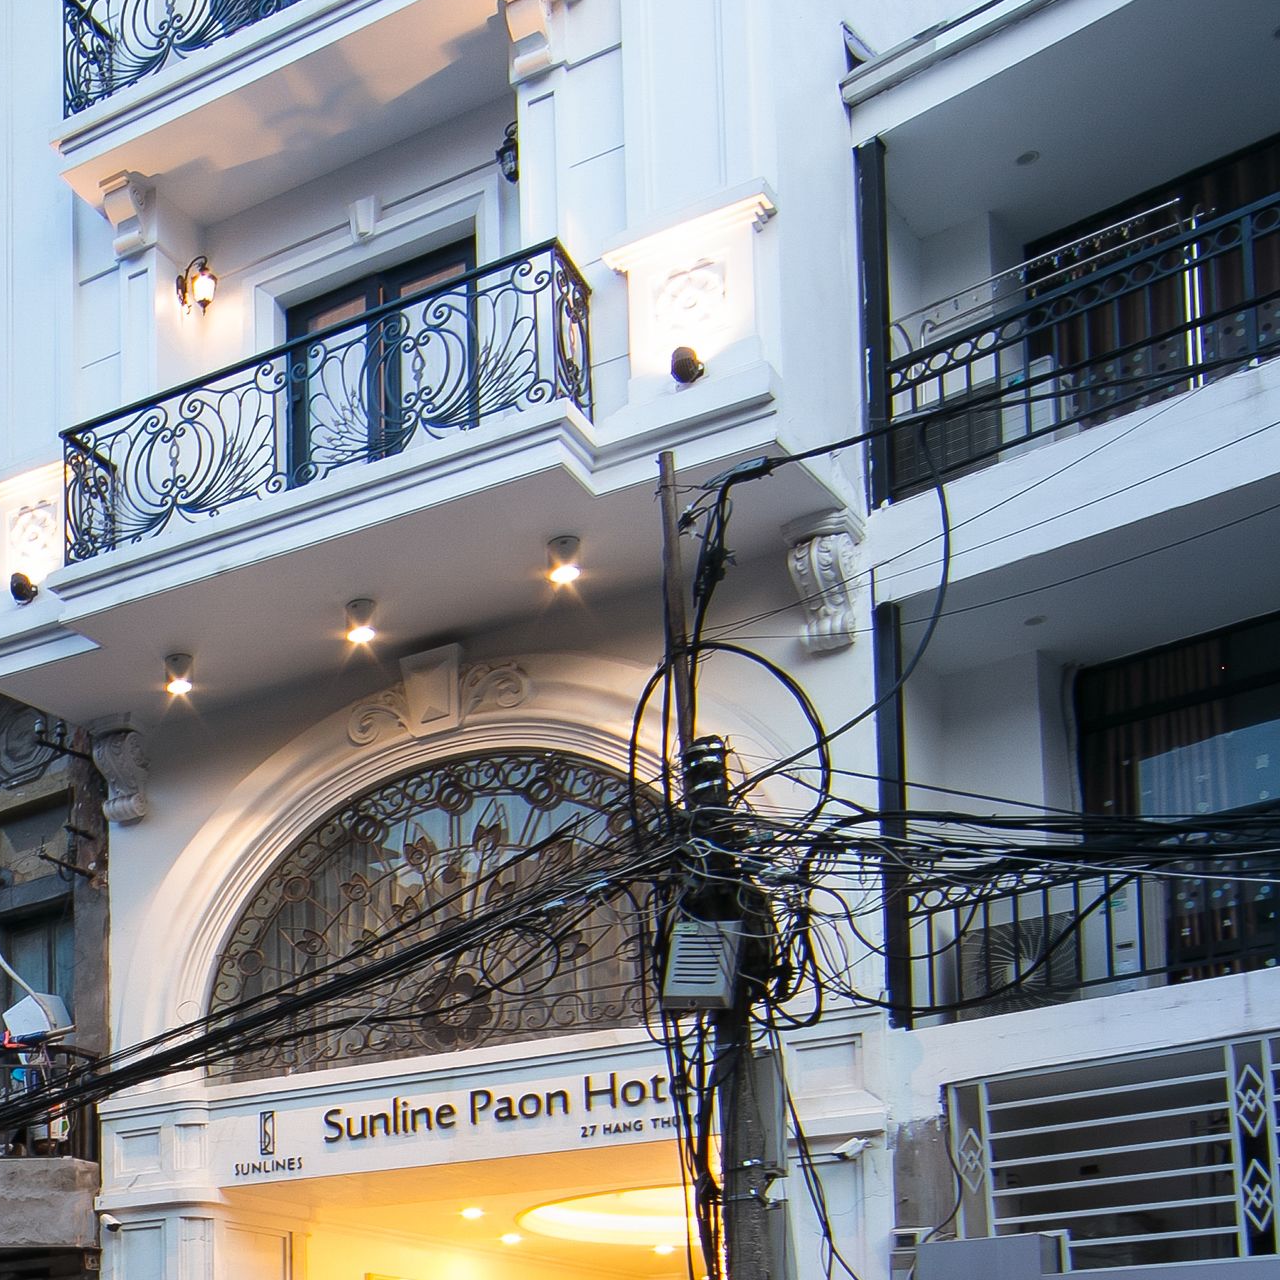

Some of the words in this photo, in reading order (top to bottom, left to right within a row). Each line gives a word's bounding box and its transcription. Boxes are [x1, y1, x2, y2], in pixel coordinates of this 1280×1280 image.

[323, 1096, 457, 1144] Sunline
[469, 1088, 569, 1126] Paon
[583, 1071, 693, 1112] Hot
[580, 1125, 597, 1138] 27
[603, 1119, 643, 1135] HANG
[234, 1156, 303, 1177] SUNLINES
